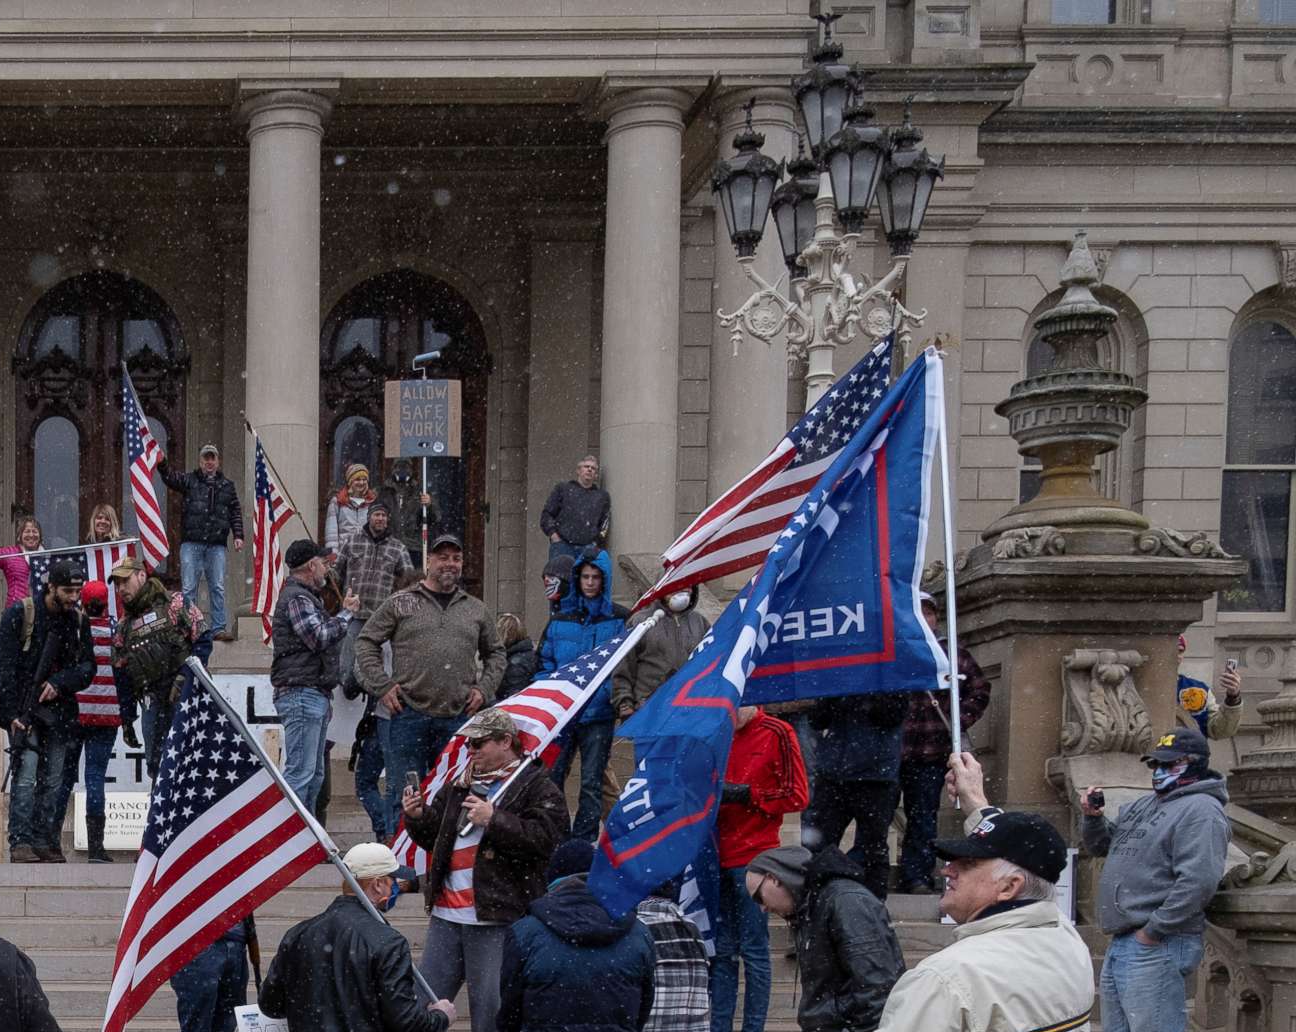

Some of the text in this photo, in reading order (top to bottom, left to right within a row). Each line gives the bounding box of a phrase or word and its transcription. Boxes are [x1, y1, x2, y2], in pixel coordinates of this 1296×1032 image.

[402, 385, 448, 400] ALLOW
[402, 404, 444, 421] SAFE
[401, 422, 445, 438] WORK
[106, 812, 143, 821] OSED
